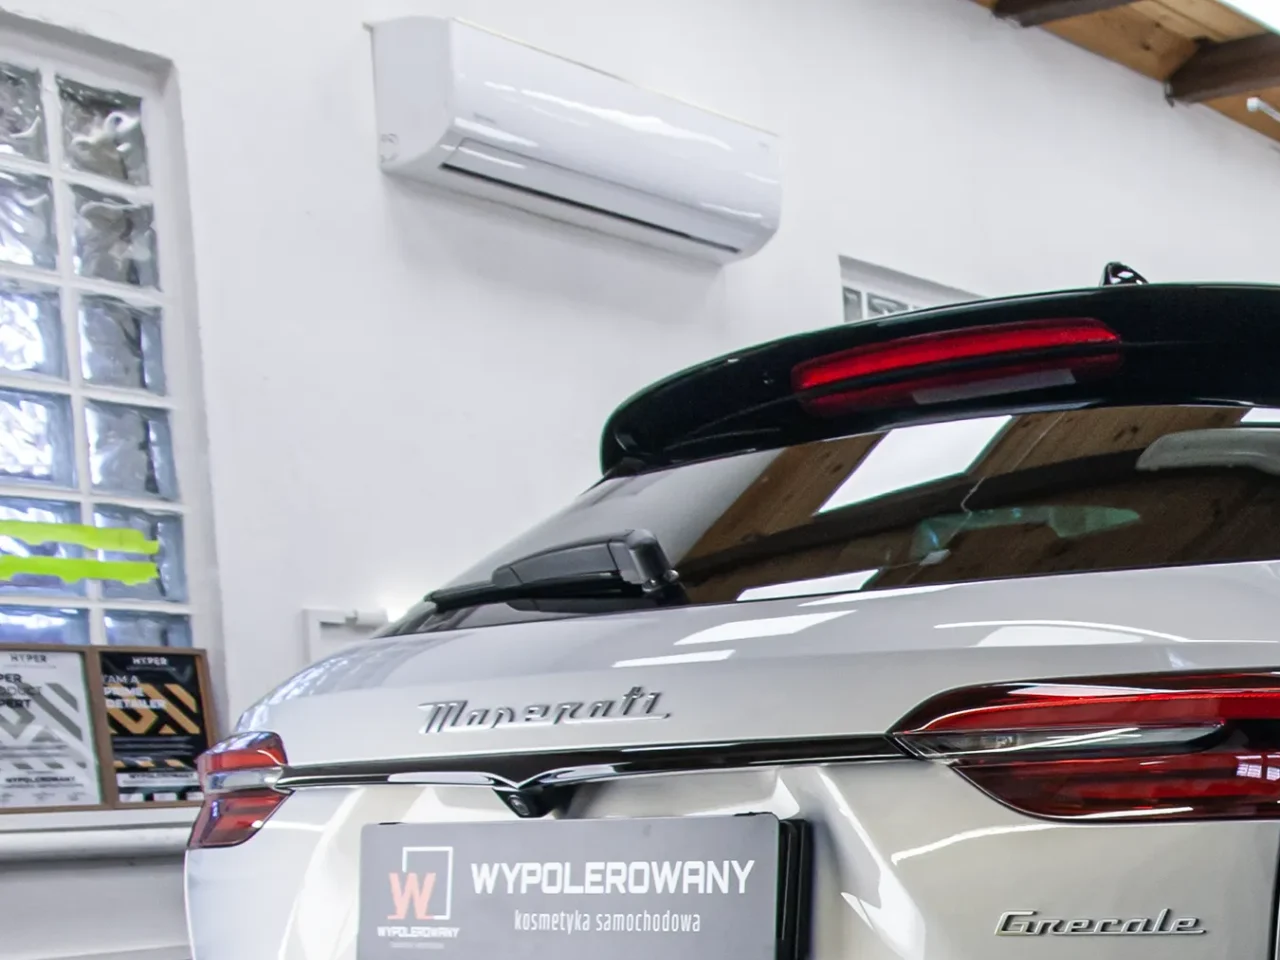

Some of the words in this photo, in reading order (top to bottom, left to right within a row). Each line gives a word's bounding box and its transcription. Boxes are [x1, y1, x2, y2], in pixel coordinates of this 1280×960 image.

[132, 656, 168, 665] HYPER
[417, 683, 672, 735] Maserati
[470, 859, 755, 895] WYPOLEROWANY
[376, 925, 461, 938] WYPOLEROWANY
[514, 910, 591, 936] kosmetyka
[595, 910, 702, 933] samochodowa
[994, 907, 1211, 937] Grecale
